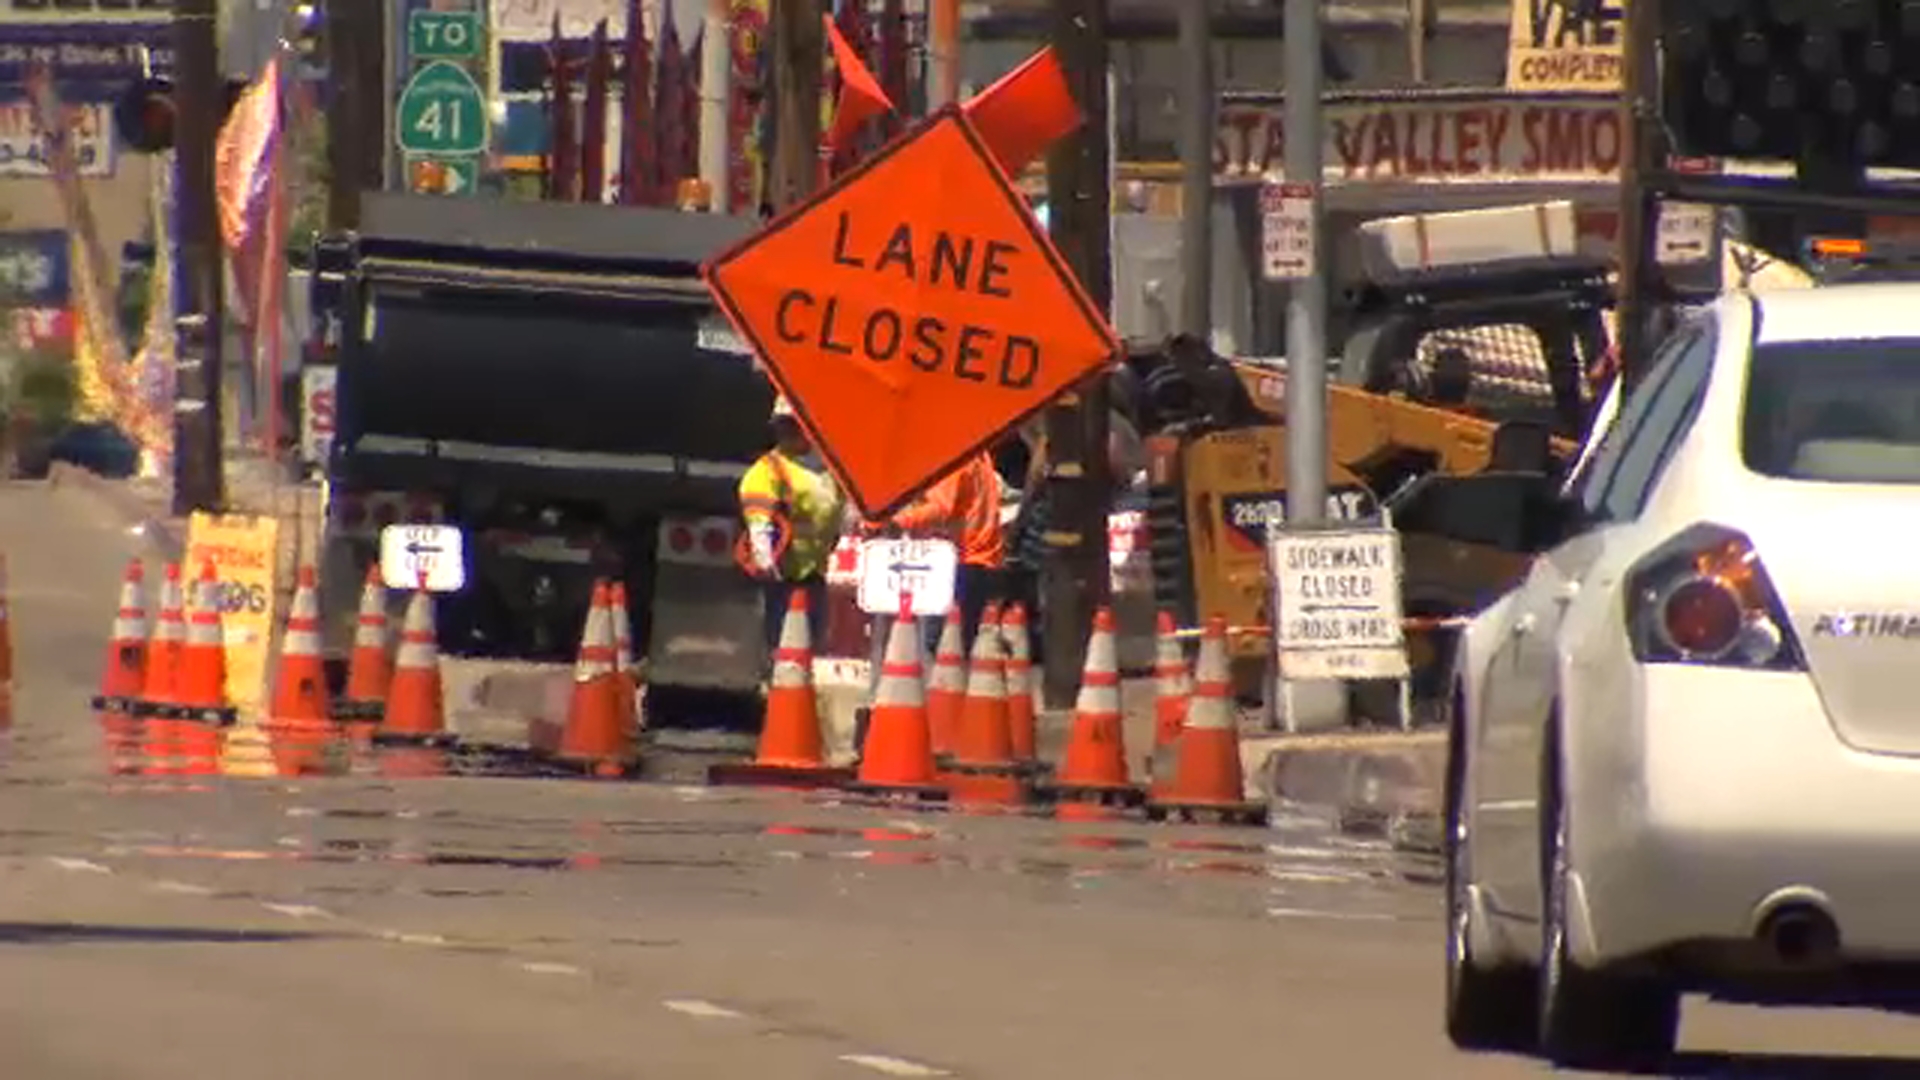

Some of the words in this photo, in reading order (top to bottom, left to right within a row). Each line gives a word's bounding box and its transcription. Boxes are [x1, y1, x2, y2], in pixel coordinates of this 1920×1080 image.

[420, 21, 467, 48] TO
[1520, 54, 1624, 82] COMPLET
[415, 100, 461, 141] 41
[1333, 107, 1510, 178] VALLEY
[1522, 106, 1623, 174] SMO
[833, 209, 1021, 298] LANE
[775, 288, 1041, 389] CLOSED
[1325, 491, 1363, 521] AT
[1287, 546, 1386, 570] SIDEWALK
[1301, 574, 1373, 599] CLOSED
